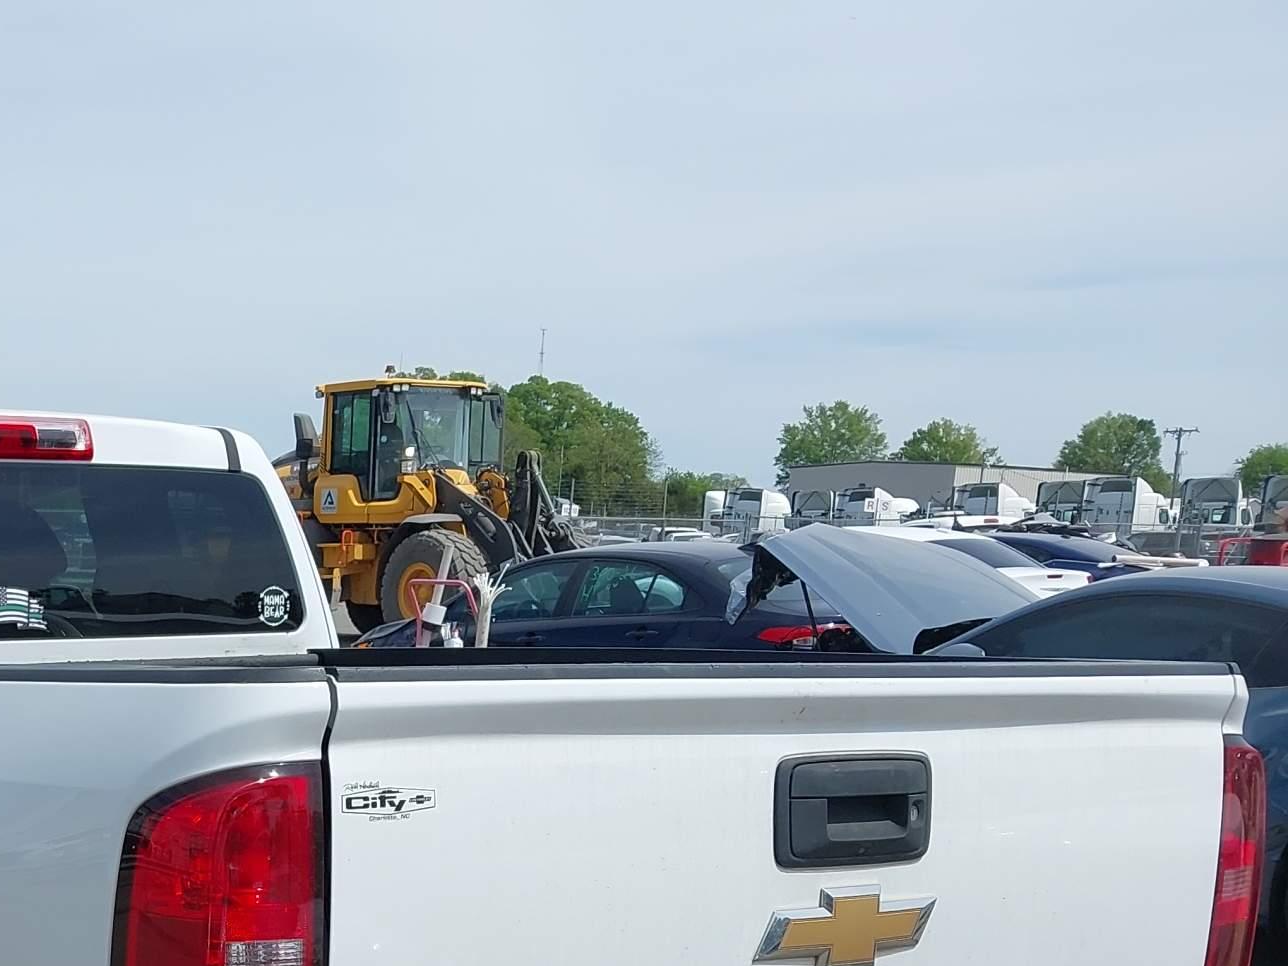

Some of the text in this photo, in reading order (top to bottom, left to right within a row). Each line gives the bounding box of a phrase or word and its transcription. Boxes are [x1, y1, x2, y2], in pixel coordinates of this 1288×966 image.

[264, 595, 285, 605] MAMA
[264, 605, 285, 618] BEAR
[345, 795, 407, 812] City
